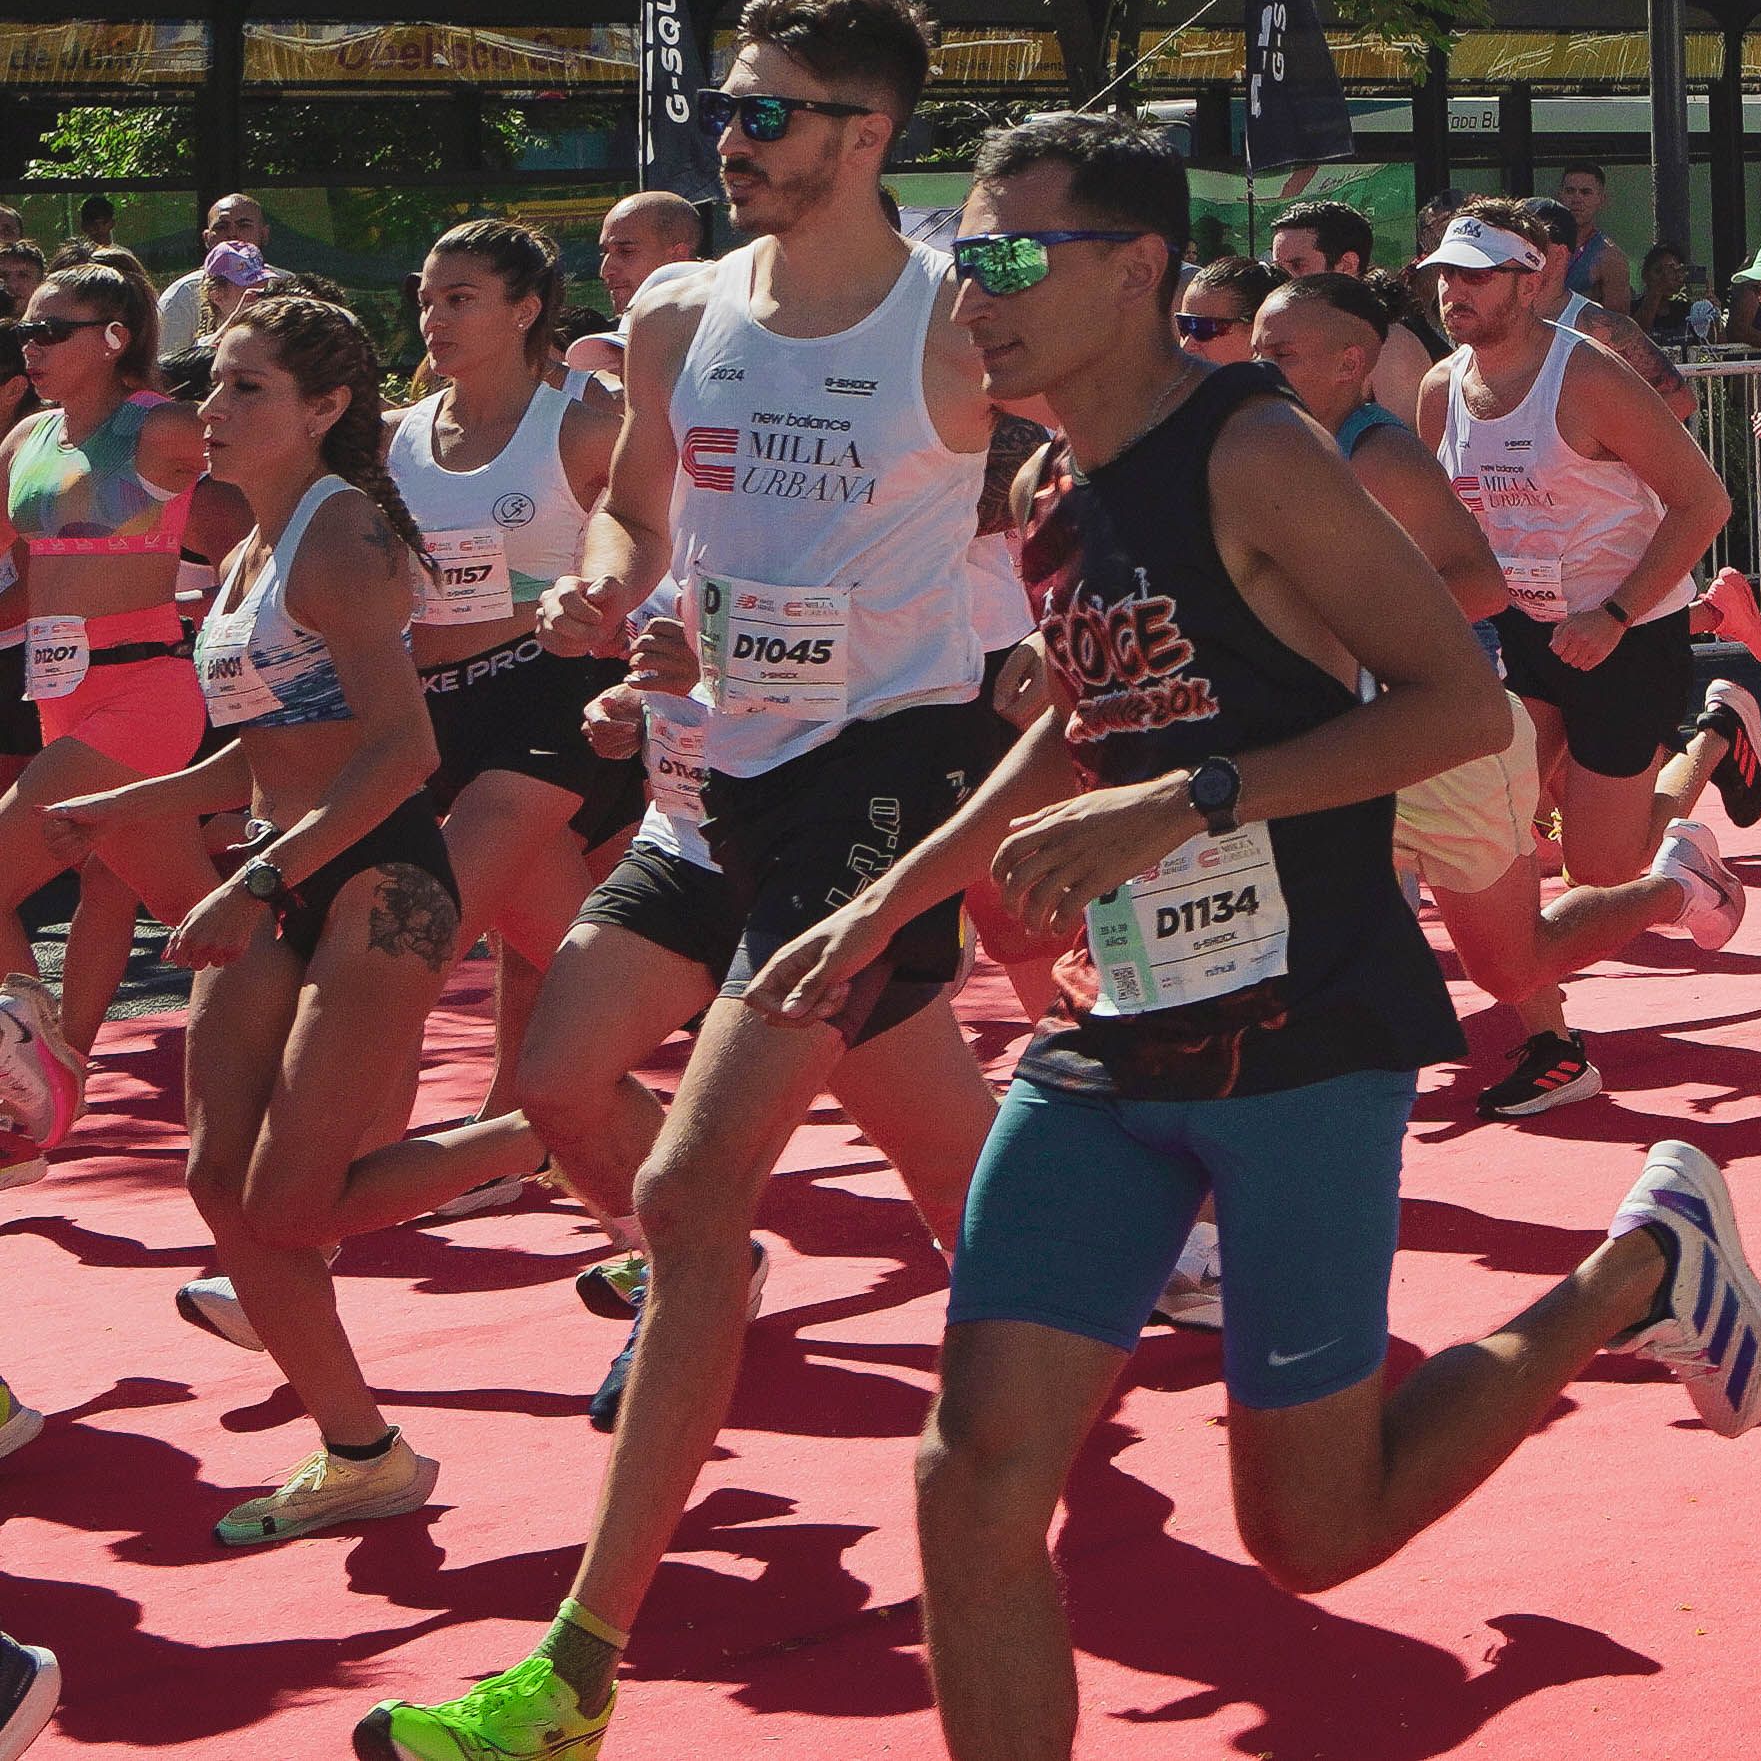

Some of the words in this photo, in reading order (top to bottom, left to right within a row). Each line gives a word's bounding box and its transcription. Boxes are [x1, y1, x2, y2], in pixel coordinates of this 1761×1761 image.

[709, 368, 745, 382] 2024
[751, 411, 784, 424] new
[785, 412, 851, 432] balance
[745, 430, 865, 469] MILLA
[741, 466, 877, 506] URBANA
[443, 564, 493, 586] 1157
[704, 582, 721, 615] D
[732, 632, 835, 665] D1045
[421, 668, 460, 694] KE
[465, 638, 544, 686] PRO
[1154, 884, 1261, 940] D1134
